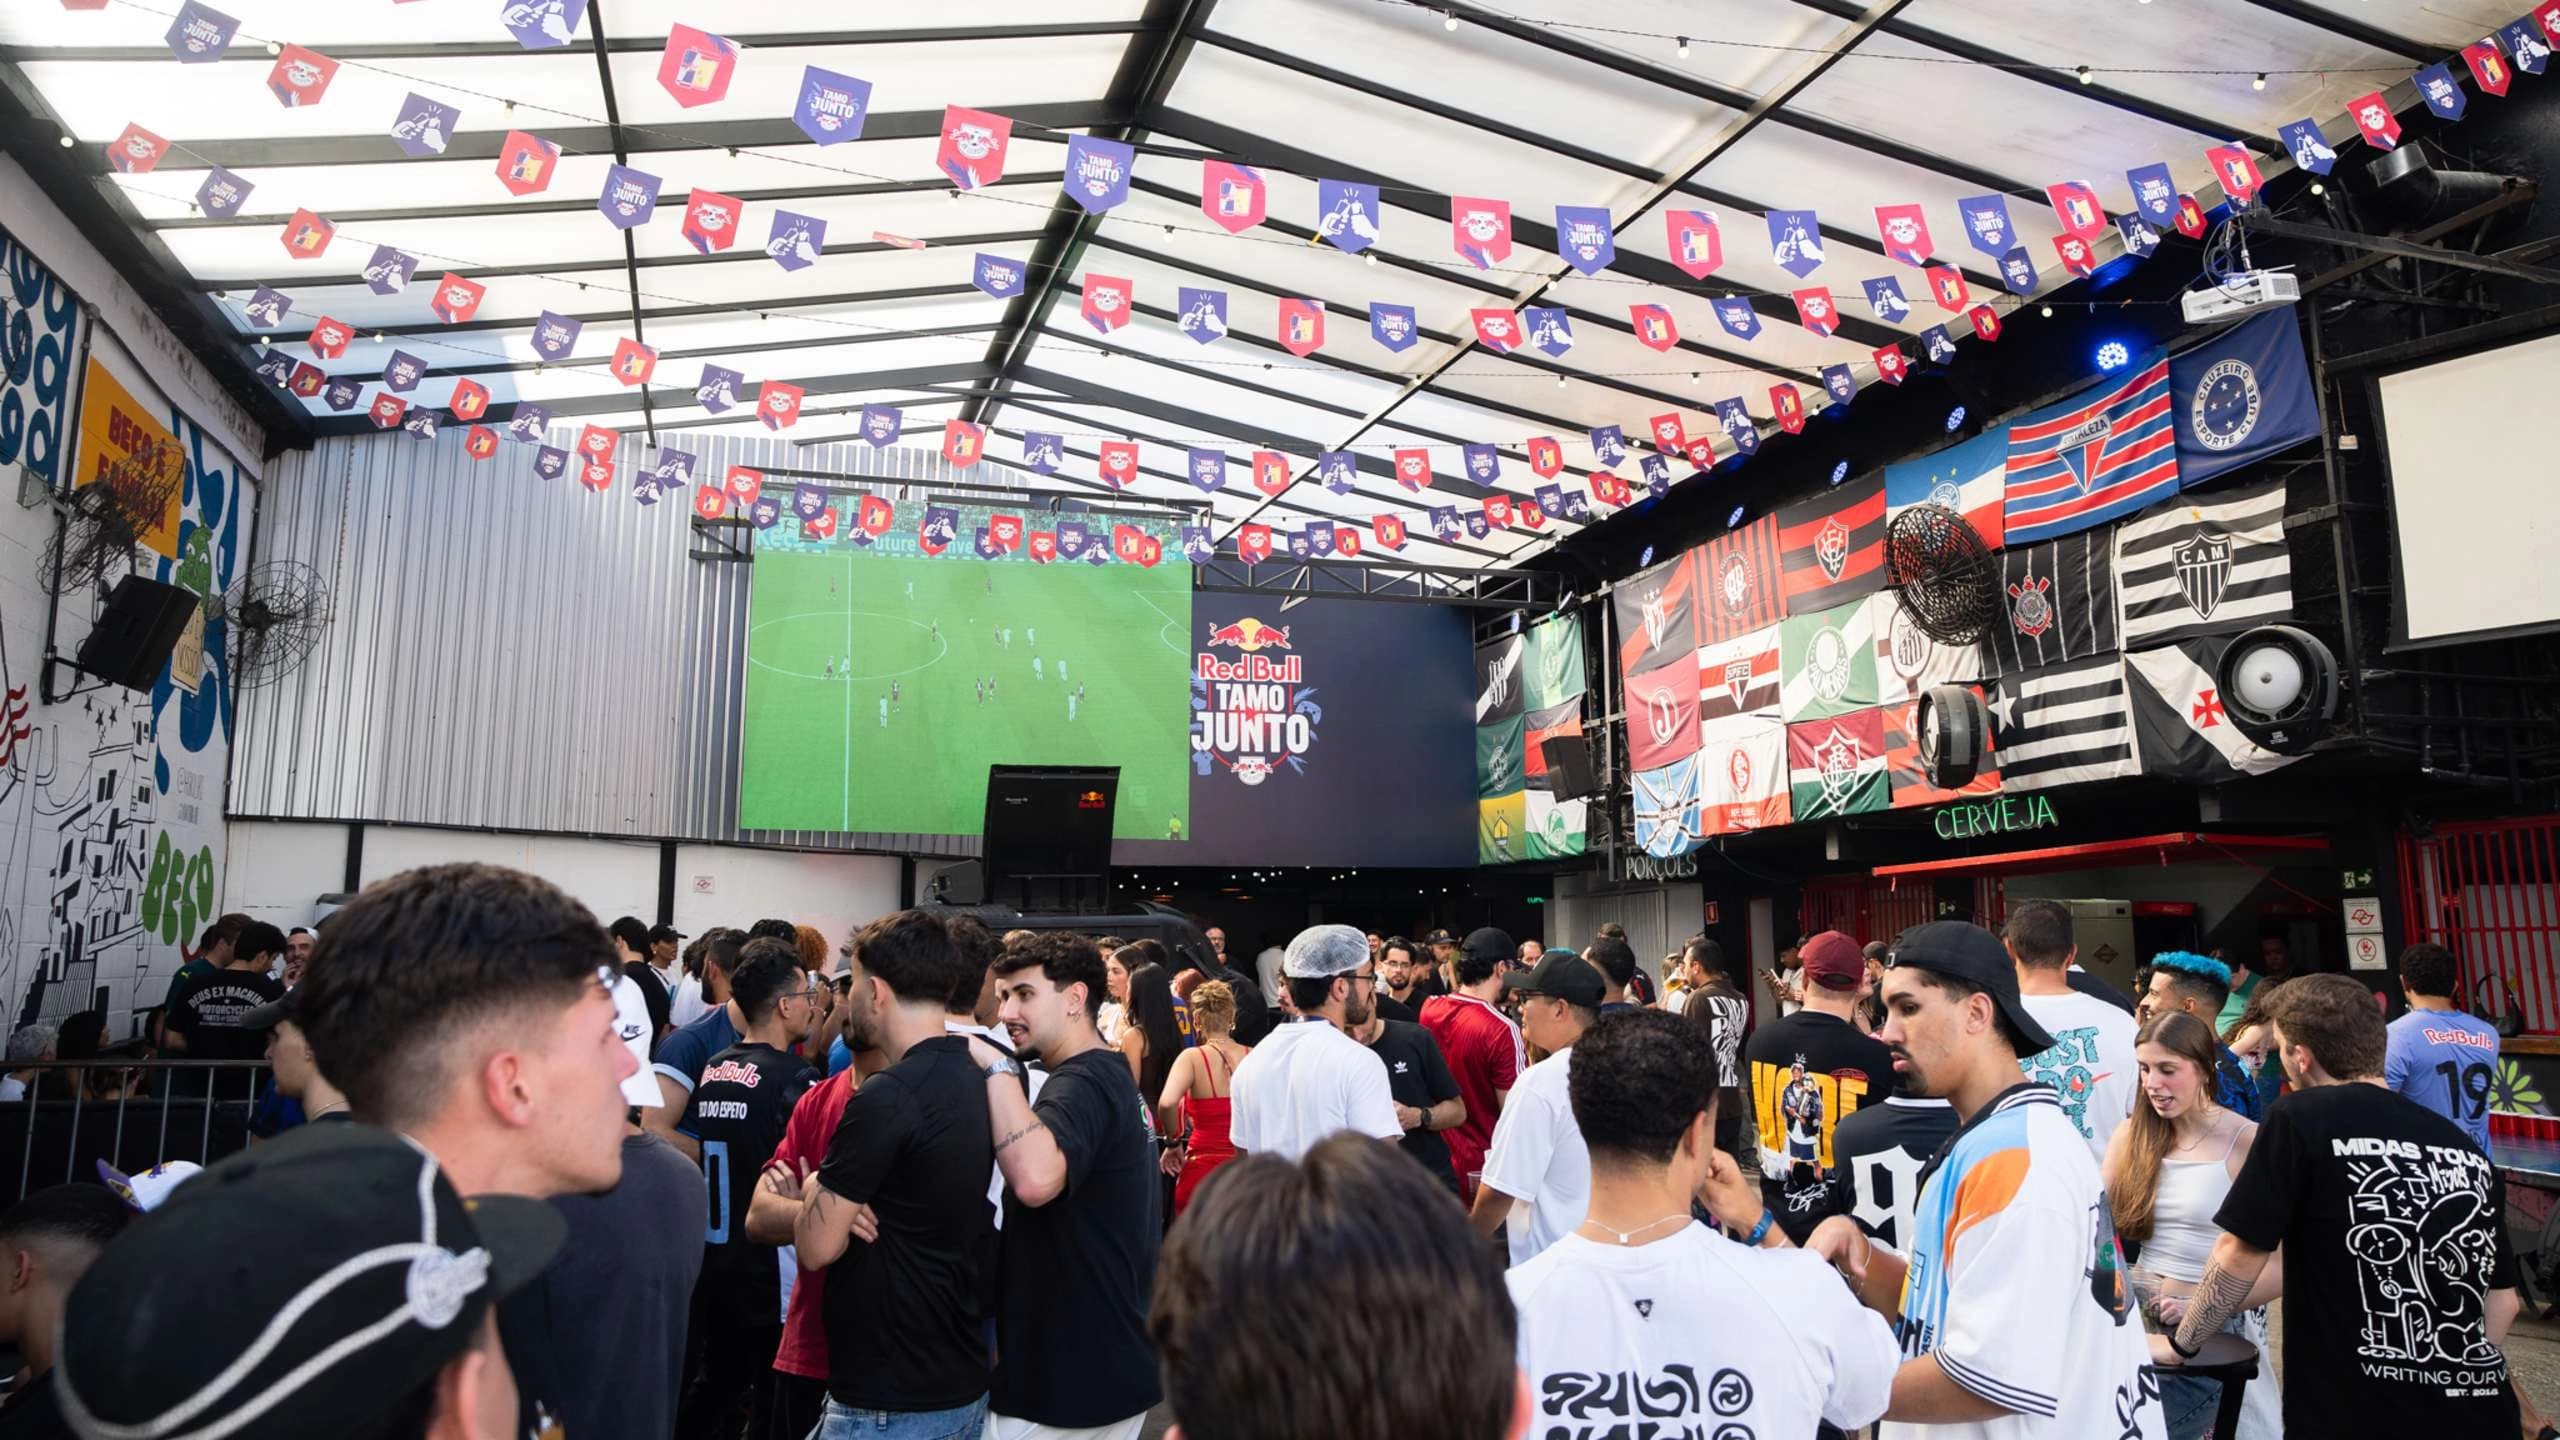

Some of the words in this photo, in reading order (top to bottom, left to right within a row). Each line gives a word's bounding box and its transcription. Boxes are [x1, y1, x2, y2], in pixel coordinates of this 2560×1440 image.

[810, 96, 855, 118] JUNTO
[822, 89, 849, 103] TAMO
[1088, 155, 1113, 167] TAMO
[1078, 163, 1120, 183] JUNTO
[613, 187, 647, 206] JUNTO
[1569, 231, 1605, 245] JUNTO
[2198, 363, 2250, 401] CRUZEIRO
[2195, 409, 2235, 446] ESPORTE
[2240, 383, 2257, 435] CLUBE
[1216, 683, 1285, 712] TAMO
[1191, 711, 1310, 754] JUNTO
[1935, 796, 2058, 840] CERVEJA
[188, 988, 212, 1009] DEUS
[211, 986, 225, 998] EX
[2436, 1060, 2493, 1120] 19
[707, 1101, 720, 1118] DO
[719, 1101, 748, 1120] ESPETO
[2331, 1138, 2422, 1160] MIDAS
[2361, 1361, 2452, 1385] WRITING
[2456, 1370, 2497, 1385] OUR
